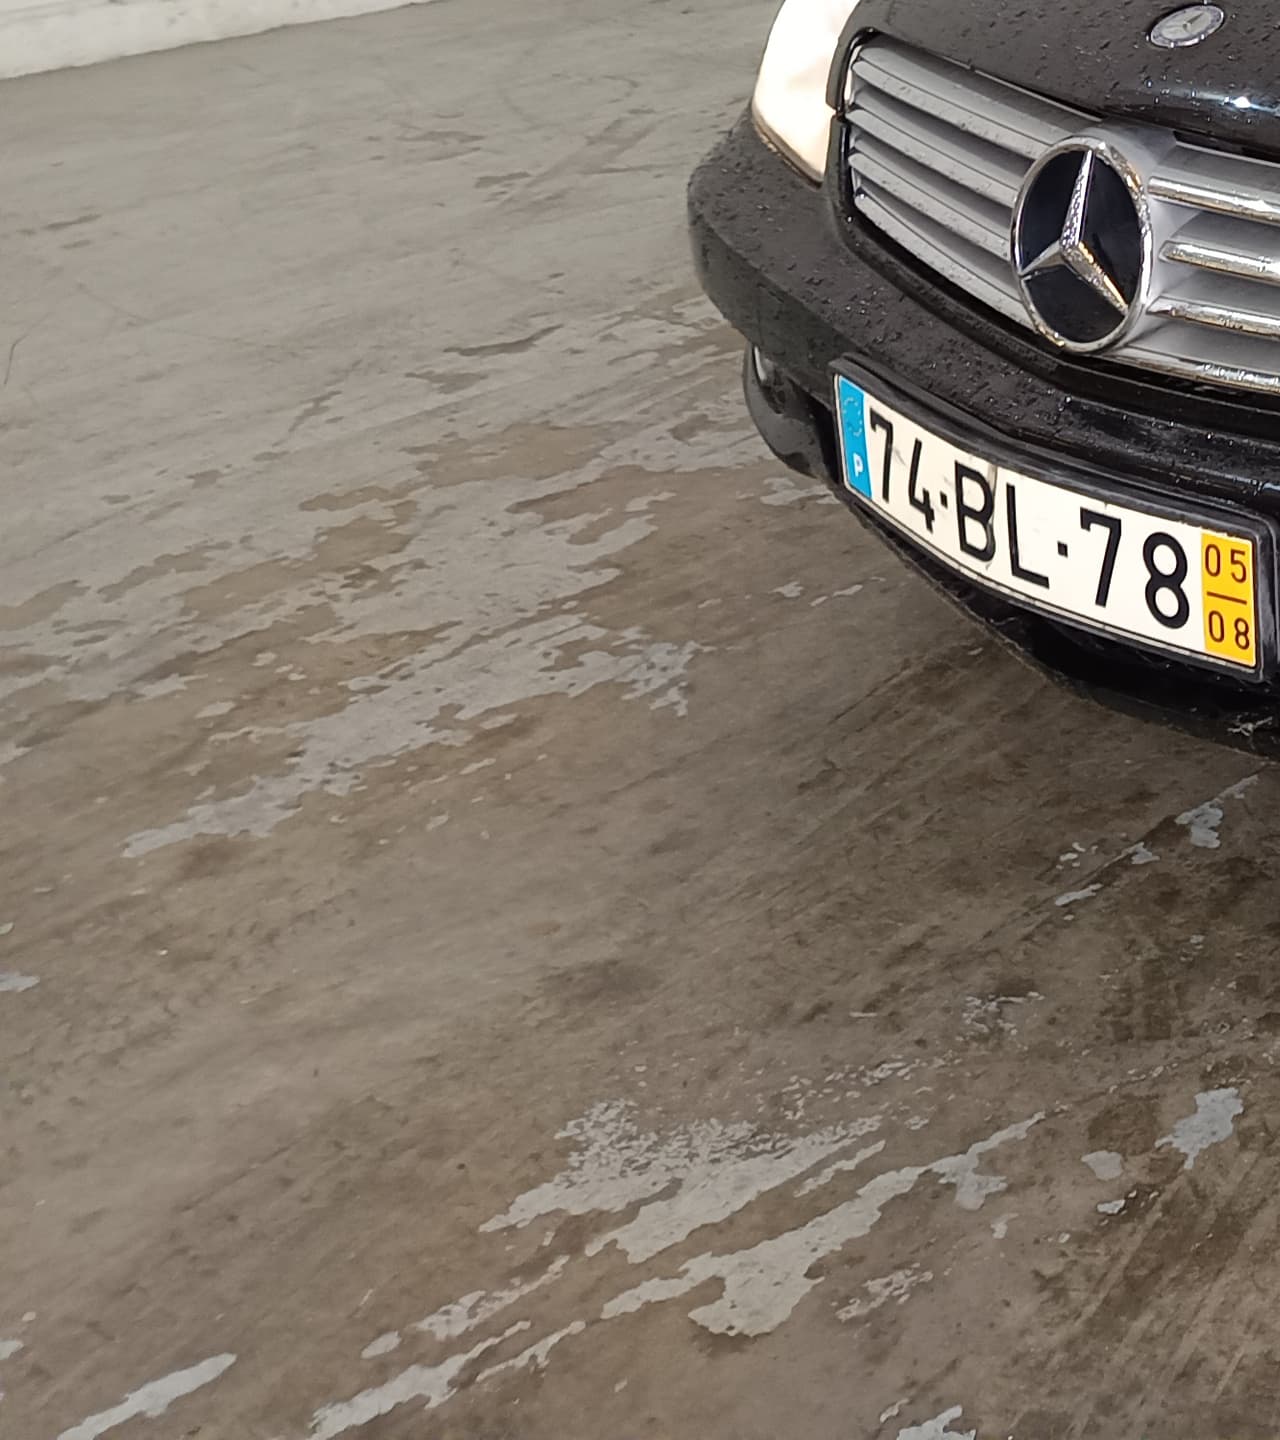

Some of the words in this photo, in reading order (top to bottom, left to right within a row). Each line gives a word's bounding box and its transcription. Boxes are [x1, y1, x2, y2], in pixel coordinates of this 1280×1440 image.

[853, 452, 864, 477] P
[1204, 543, 1248, 584] 05
[1208, 611, 1250, 650] 08
